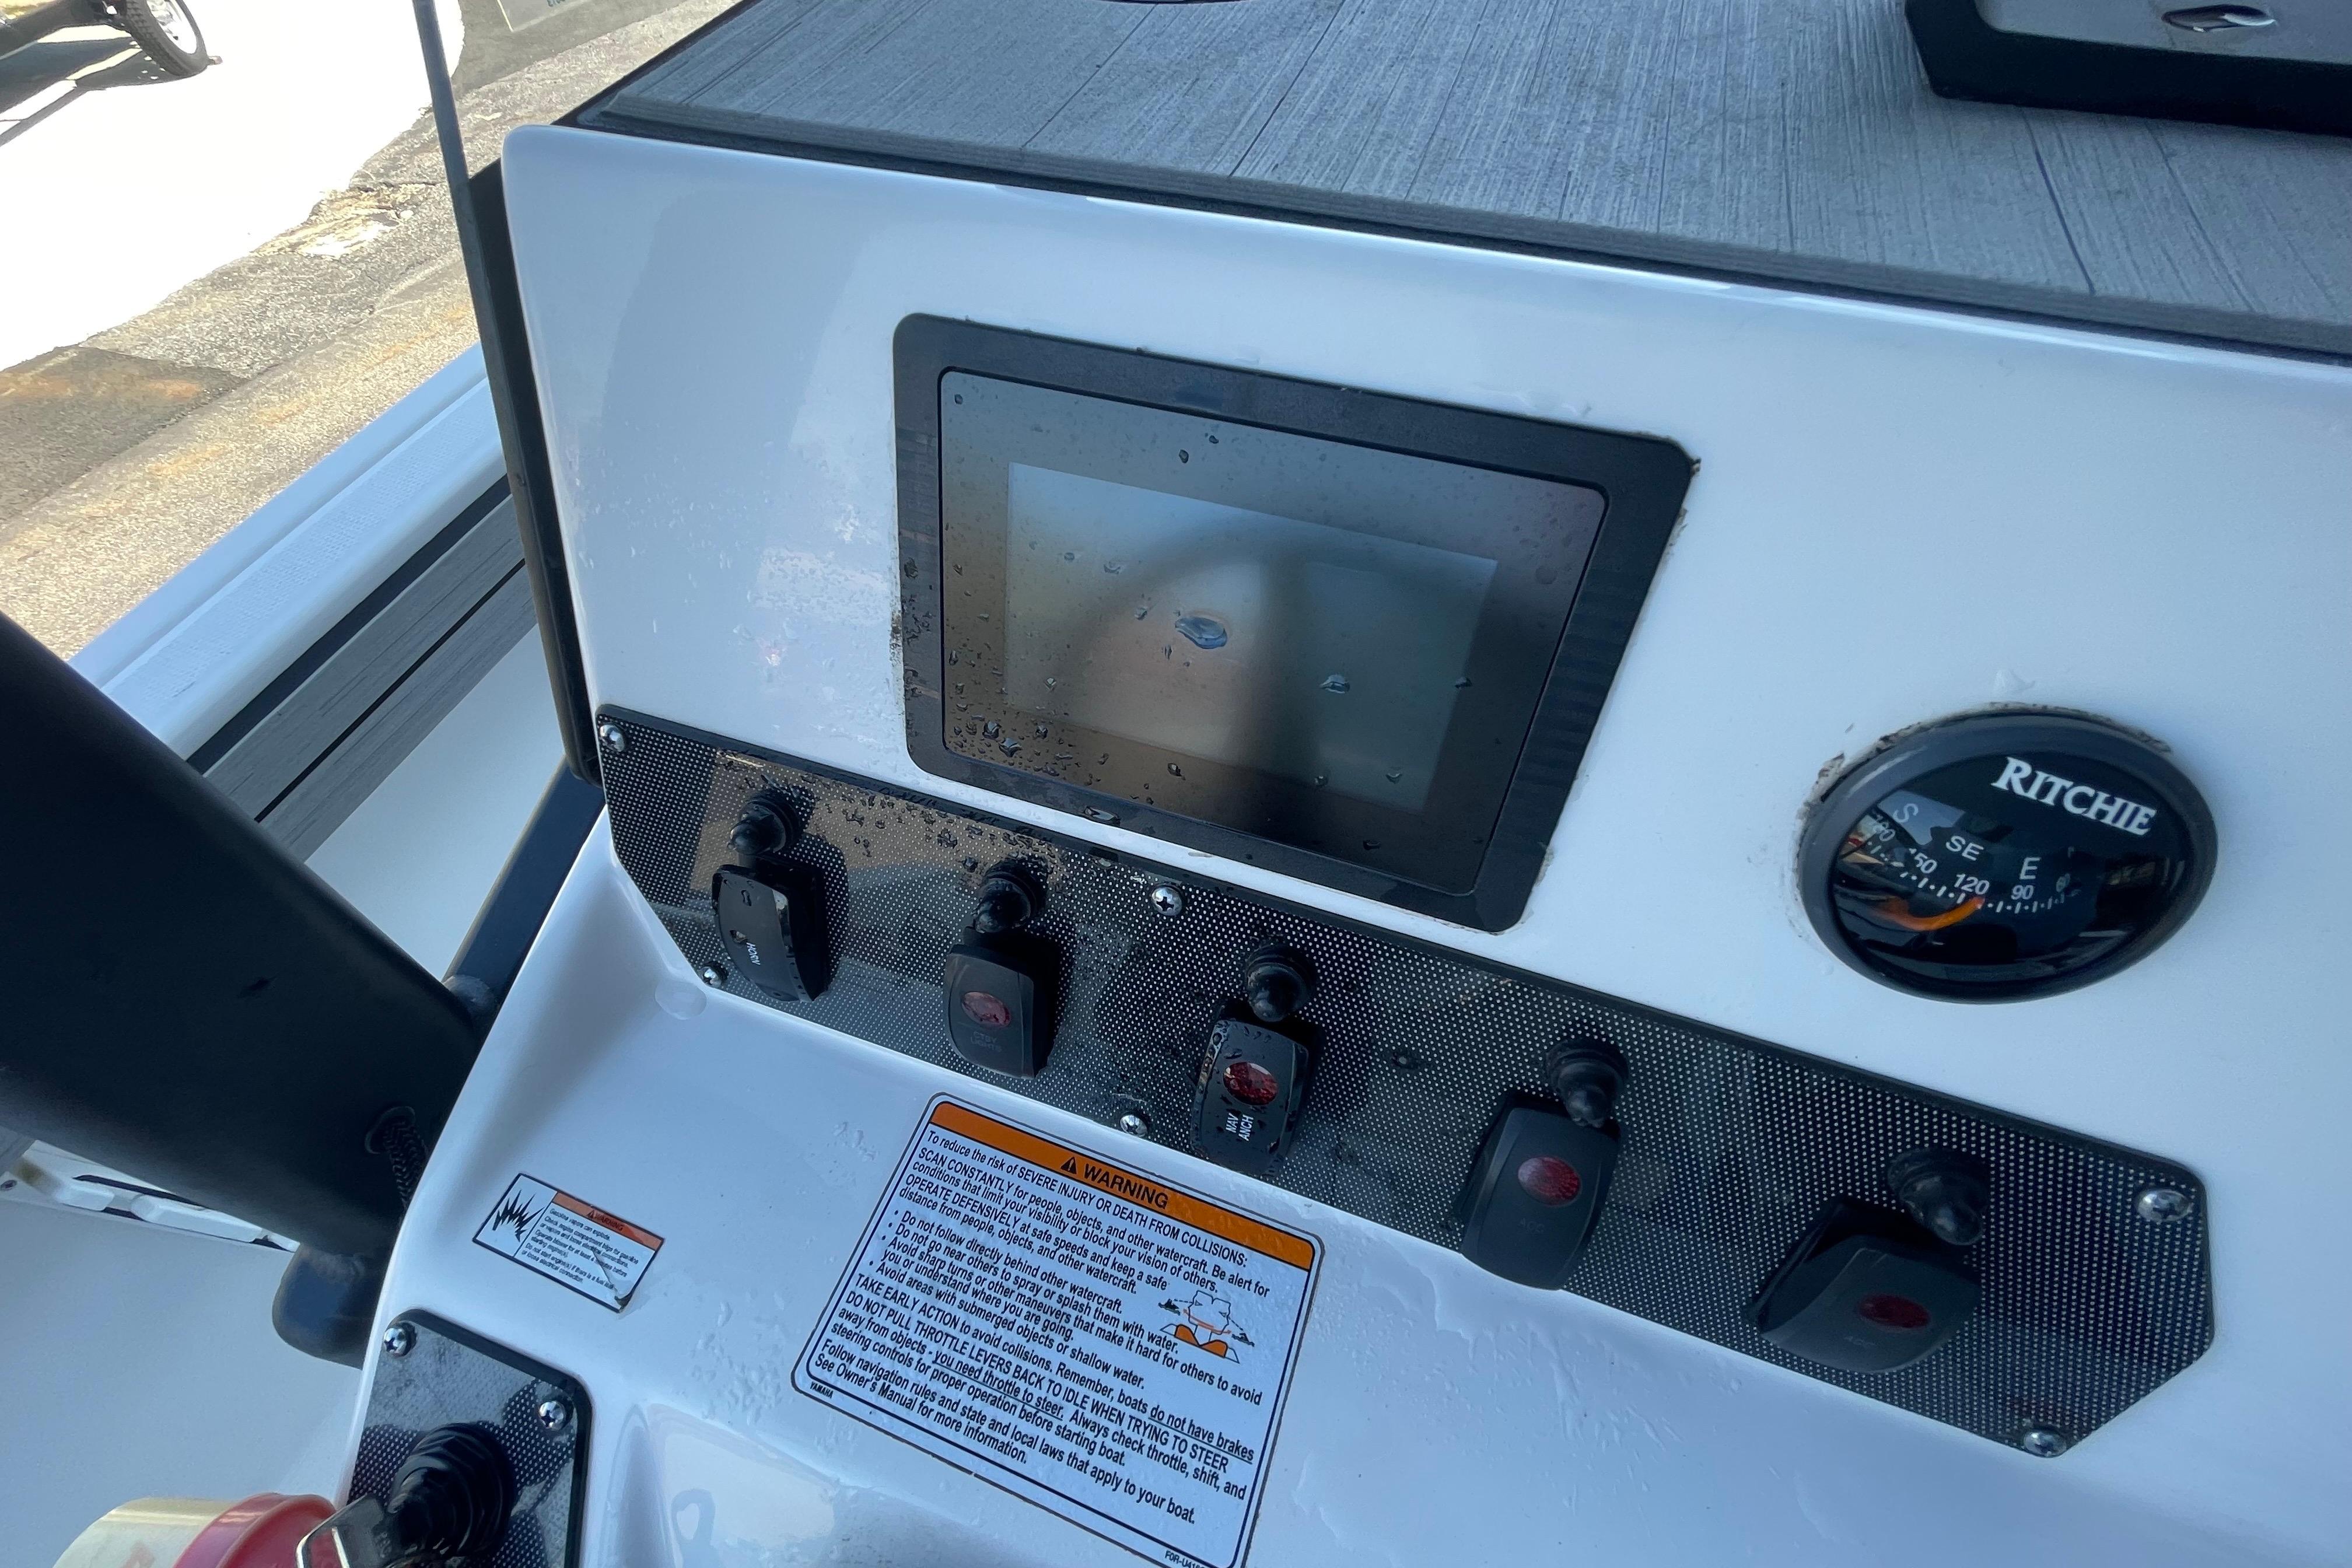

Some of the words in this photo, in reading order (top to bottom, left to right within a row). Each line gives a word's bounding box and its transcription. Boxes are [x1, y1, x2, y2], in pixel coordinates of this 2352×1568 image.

[1893, 803, 1919, 823] S
[1945, 835, 1985, 862] SE
[2020, 857, 2041, 880] E
[1992, 757, 2157, 835] RITCHIE
[1954, 873, 1990, 897] 120
[2011, 884, 2034, 901] 90
[746, 942, 761, 966] HORN
[1225, 1113, 1239, 1133] NAV
[1238, 1115, 1254, 1141] ANCH
[594, 1213, 624, 1230] WARNING
[904, 1173, 953, 1202] OPERATE
[951, 1192, 1020, 1228] DEFENSIVELY
[1019, 1220, 1031, 1234] at
[1030, 1226, 1053, 1243] safe
[1052, 1234, 1090, 1259] speeds
[1090, 1250, 1111, 1267] and
[1110, 1256, 1136, 1280] keep
[1136, 1270, 1144, 1281] a
[1144, 1272, 1168, 1290] safe
[918, 1147, 947, 1167] SCAN
[946, 1158, 1014, 1194] CONSTANTLY
[1013, 1185, 1029, 1200] for
[1027, 1192, 1064, 1218] people,
[1065, 1206, 1105, 1234] objects,
[1105, 1223, 1127, 1240] and
[1127, 1231, 1155, 1251] other
[1155, 1242, 1209, 1273] watercraft.
[1211, 1264, 1227, 1280] Be
[1227, 1270, 1253, 1290] alert
[1253, 1280, 1270, 1297] for
[926, 1130, 940, 1144] To
[939, 1136, 971, 1157] reduce
[971, 1148, 987, 1163] the
[986, 1155, 1006, 1171] risk
[1006, 1163, 1019, 1175] of
[1017, 1166, 1058, 1191] SEVERE
[1057, 1182, 1096, 1206] INJURY
[1094, 1197, 1112, 1213] OR
[1112, 1203, 1148, 1227] DEATH
[1148, 1217, 1180, 1240] FROM
[1181, 1230, 1248, 1267] COLLISIONS:
[1081, 1163, 1170, 1209] WARNING
[894, 1223, 911, 1239] Do
[910, 1231, 930, 1247] not
[926, 1240, 942, 1254] go
[942, 1245, 967, 1262] near
[966, 1254, 1000, 1276] others
[1000, 1267, 1013, 1282] to
[1012, 1275, 1043, 1297] spray
[1043, 1288, 1056, 1301] or
[1055, 1292, 1092, 1318] splash
[1092, 1306, 1121, 1328] them
[1121, 1318, 1145, 1338] with
[1146, 1329, 1181, 1353] water.
[901, 1210, 917, 1226] Do
[916, 1218, 936, 1234] not
[933, 1224, 966, 1246] follow
[964, 1237, 1004, 1265] directly
[1003, 1252, 1041, 1278] behind
[1040, 1269, 1069, 1290] other
[1068, 1281, 1124, 1314] watercraft.
[854, 1273, 884, 1296] TAKE
[882, 1286, 919, 1312] EARLY
[917, 1302, 960, 1330] ACTION
[959, 1320, 972, 1335] to
[971, 1326, 1002, 1349] avoid
[1001, 1339, 1055, 1373] collisions.
[1055, 1362, 1115, 1401] Remember,
[1116, 1388, 1149, 1414] boats
[1149, 1404, 1166, 1422] do
[1166, 1412, 1186, 1432] not
[1186, 1419, 1214, 1443] have
[1216, 1432, 1255, 1461] brakes
[875, 1261, 907, 1283] Avoid
[905, 1276, 934, 1296] areas
[934, 1287, 957, 1306] with
[956, 1297, 1016, 1334] submerged
[1015, 1322, 1055, 1350] objects
[1056, 1342, 1069, 1354] or
[1069, 1345, 1112, 1373] shallow
[1112, 1364, 1146, 1388] water.
[887, 1236, 919, 1258] Avoid
[916, 1250, 947, 1274] sharp
[946, 1261, 974, 1283] turns
[974, 1275, 987, 1288] or
[986, 1279, 1016, 1300] other
[1014, 1292, 1072, 1324] maneuvers
[1072, 1314, 1096, 1334] that
[1094, 1324, 1125, 1346] make
[1125, 1336, 1135, 1351] it
[1134, 1339, 1161, 1362] hard
[1161, 1351, 1180, 1370] for
[1180, 1360, 1216, 1385] others
[1216, 1374, 1229, 1391] to
[1230, 1381, 1262, 1405] avoid
[810, 1381, 834, 1399] YAMAHA
[814, 1353, 835, 1373] See
[835, 1363, 880, 1393] Owner's
[877, 1382, 918, 1411] Manual
[916, 1400, 935, 1419] for
[933, 1410, 963, 1433] more
[963, 1421, 1028, 1464] information.
[821, 1339, 857, 1366] Follow
[854, 1356, 910, 1392] navigation
[909, 1380, 938, 1403] rules
[937, 1394, 961, 1413] and
[959, 1404, 988, 1426] state
[987, 1416, 1012, 1437] and
[1010, 1425, 1040, 1450] local
[1038, 1438, 1065, 1462] laws
[1065, 1451, 1090, 1474] that
[1088, 1463, 1124, 1492] apply
[1124, 1477, 1136, 1496] to
[1136, 1487, 1166, 1511] your
[1167, 1497, 1196, 1524] boat.
[845, 1291, 863, 1308] DO
[861, 1298, 887, 1318] NOT
[884, 1308, 912, 1331] PULL
[912, 1321, 970, 1356] THROTTLE
[967, 1345, 1012, 1376] LEVERS
[1012, 1364, 1045, 1391] BACK
[1045, 1379, 1063, 1398] TO
[1062, 1387, 1090, 1410] IDLE
[1089, 1399, 1126, 1427] WHEN
[1126, 1415, 1170, 1447] TRYING
[1170, 1434, 1188, 1455] TO
[1189, 1443, 1228, 1474] STEER
